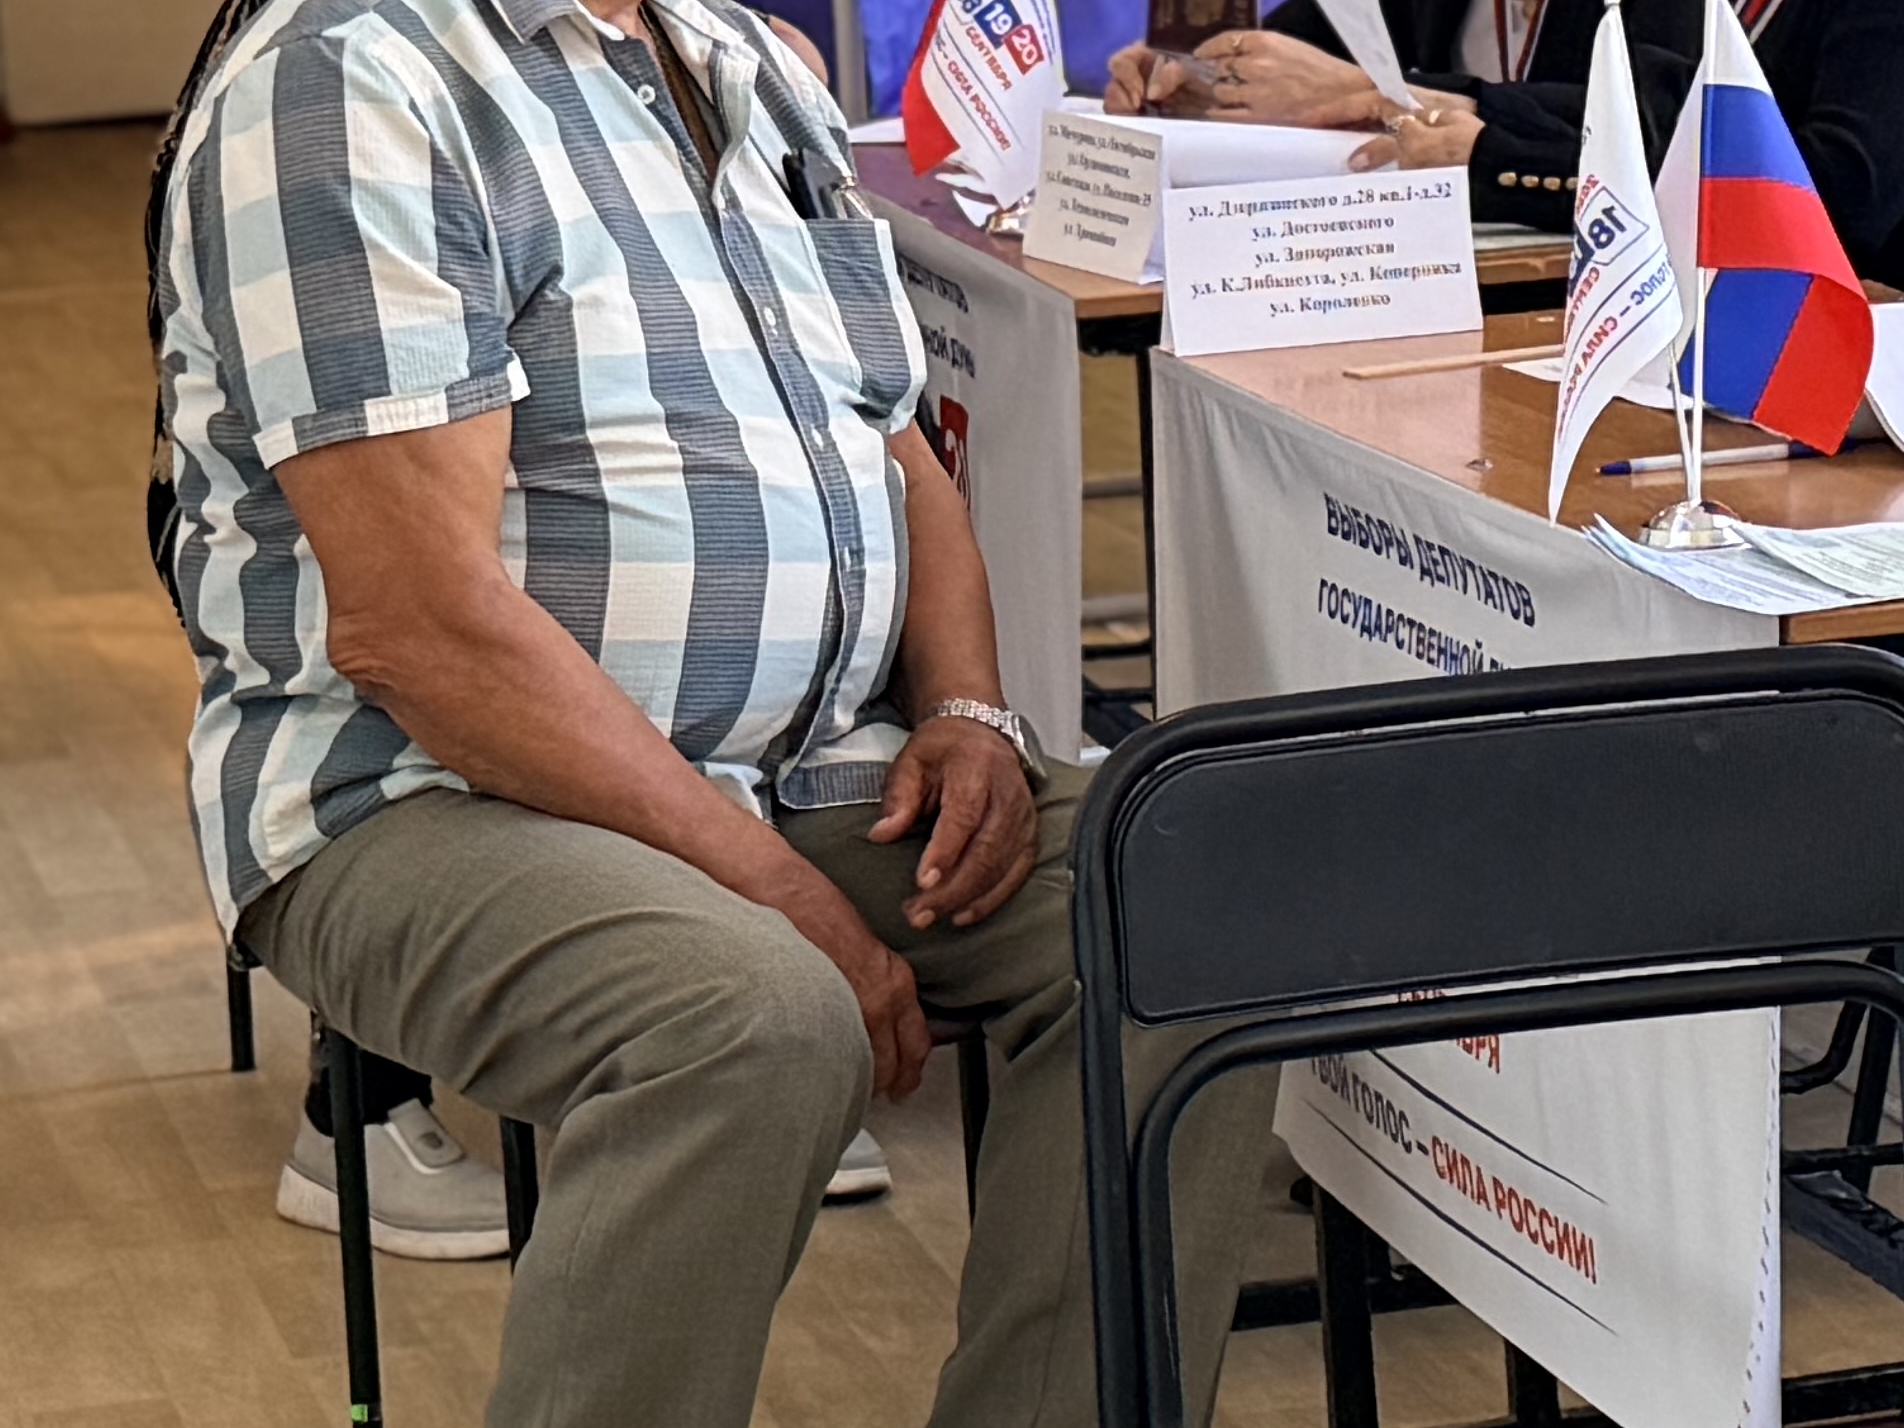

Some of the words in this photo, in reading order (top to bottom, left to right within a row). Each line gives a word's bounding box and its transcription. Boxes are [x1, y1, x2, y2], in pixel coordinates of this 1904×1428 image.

[984, 2, 1013, 36] 19
[1013, 30, 1039, 67] 20
[1323, 491, 1414, 571] ВЫБОРЫ
[1412, 532, 1536, 629] ДЕПУТАТОВ
[1317, 577, 1485, 676] ГОСУДАРСТВЕННОЙ
[1352, 1071, 1412, 1155] ГОЛОС
[1430, 1134, 1493, 1213] СИЛА
[1491, 1175, 1597, 1285] РОССИИ!
